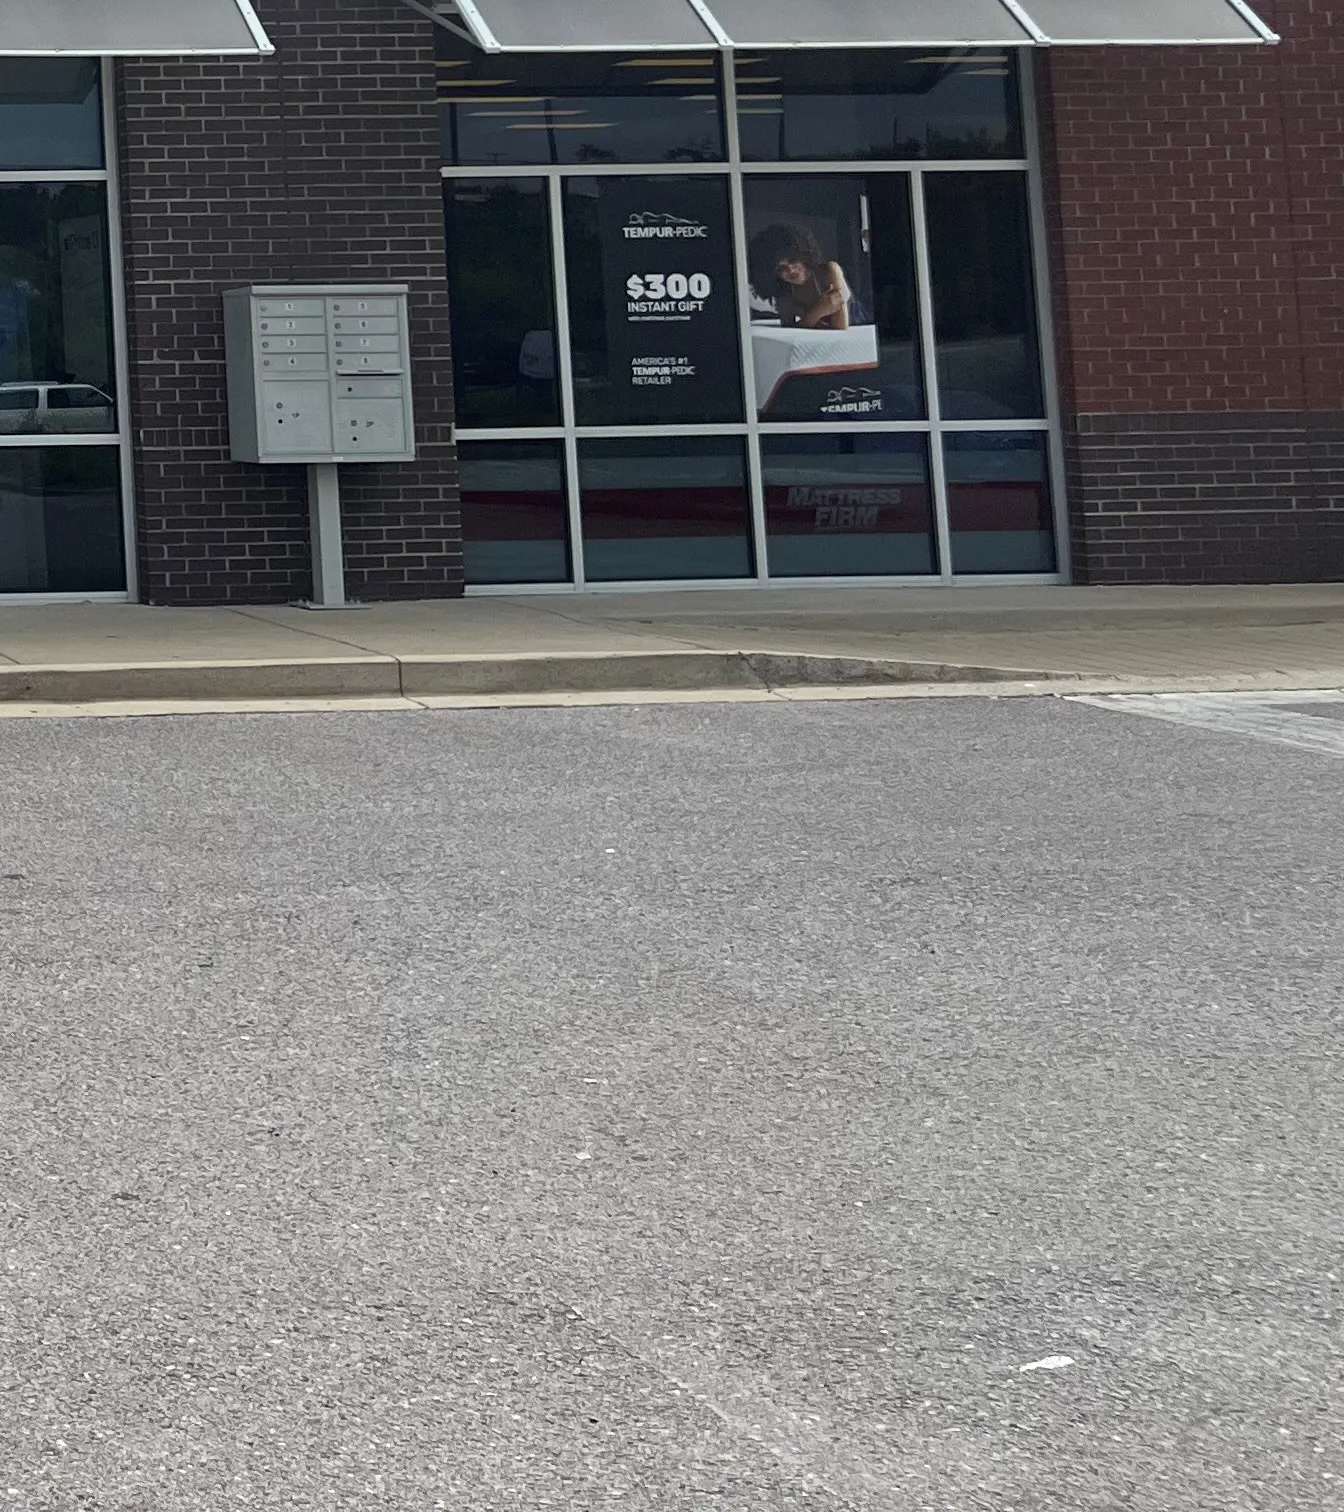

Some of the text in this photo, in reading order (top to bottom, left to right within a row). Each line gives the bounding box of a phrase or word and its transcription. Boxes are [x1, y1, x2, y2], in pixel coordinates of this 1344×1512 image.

[622, 226, 708, 239] TEMPUR-PEDIC
[626, 273, 711, 300] $300
[627, 301, 705, 312] INSTANT GIFT
[632, 376, 672, 385] RETAILER
[787, 487, 901, 506] MATTRESS
[815, 506, 879, 527] FIRM
